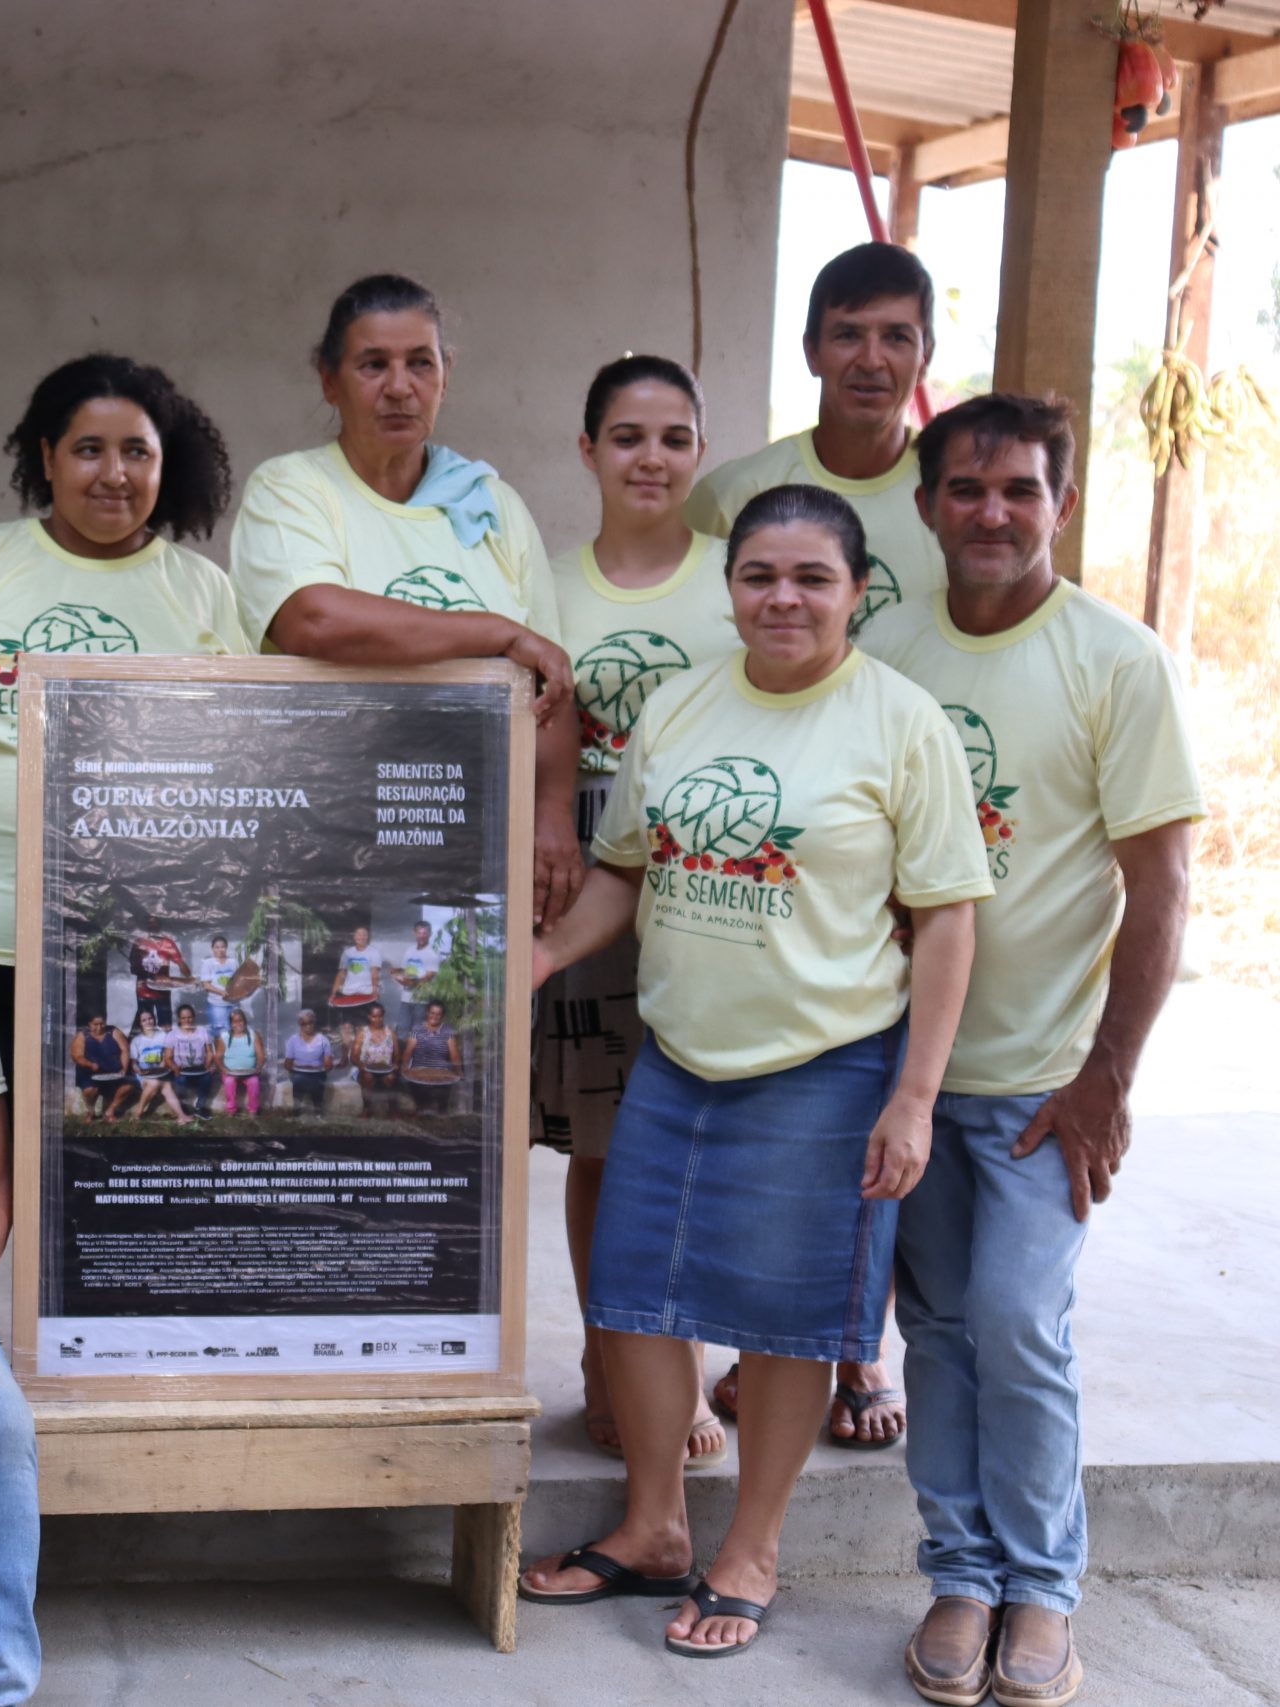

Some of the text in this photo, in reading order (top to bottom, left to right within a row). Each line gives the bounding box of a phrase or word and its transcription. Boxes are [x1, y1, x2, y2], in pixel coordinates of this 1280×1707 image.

[74, 761, 214, 775] SÉRIE MINIDOCUMENTÁRIOS
[377, 763, 463, 779] SEMENTES DA
[71, 786, 311, 810] QUEM CONSERVA
[377, 784, 465, 805] RESTAURAÇÃO
[377, 808, 465, 823] NO PORTAL DA
[70, 814, 260, 840] A AMAZÔNIA?
[377, 827, 444, 846] AMAZÔNIA
[686, 874, 794, 919] SEMENTES
[656, 904, 763, 932] PORTAL DA AMAZÔNIA
[112, 1164, 161, 1174] Organização
[221, 1162, 273, 1171] COOPERATIVA
[275, 1161, 336, 1171] AGROPECUÁRIA
[338, 1162, 363, 1171] MISTA
[364, 1162, 374, 1171] DE
[375, 1162, 397, 1171] NOVA
[74, 1181, 106, 1190] Projeto:
[109, 1179, 129, 1188] REDE
[130, 1179, 140, 1188] DE
[142, 1179, 182, 1188] SEMENTES
[183, 1179, 213, 1188] PORTAL
[215, 1179, 226, 1188] DA
[271, 1178, 329, 1188] FORTALECENDO
[330, 1178, 337, 1188] A
[338, 1178, 392, 1188] AGRICULTURA
[392, 1178, 429, 1188] FAMILIAR
[430, 1178, 441, 1188] NO
[443, 1178, 468, 1188] NORTE
[95, 1195, 164, 1204] MATOGROSSENSE
[214, 1195, 233, 1204] ALTA
[234, 1195, 271, 1204] FLORESTA
[278, 1194, 300, 1204] NOVA
[301, 1194, 335, 1204] GUARITA
[341, 1194, 354, 1204] MT
[386, 1194, 406, 1204] REDE
[407, 1194, 448, 1204] SEMENTES
